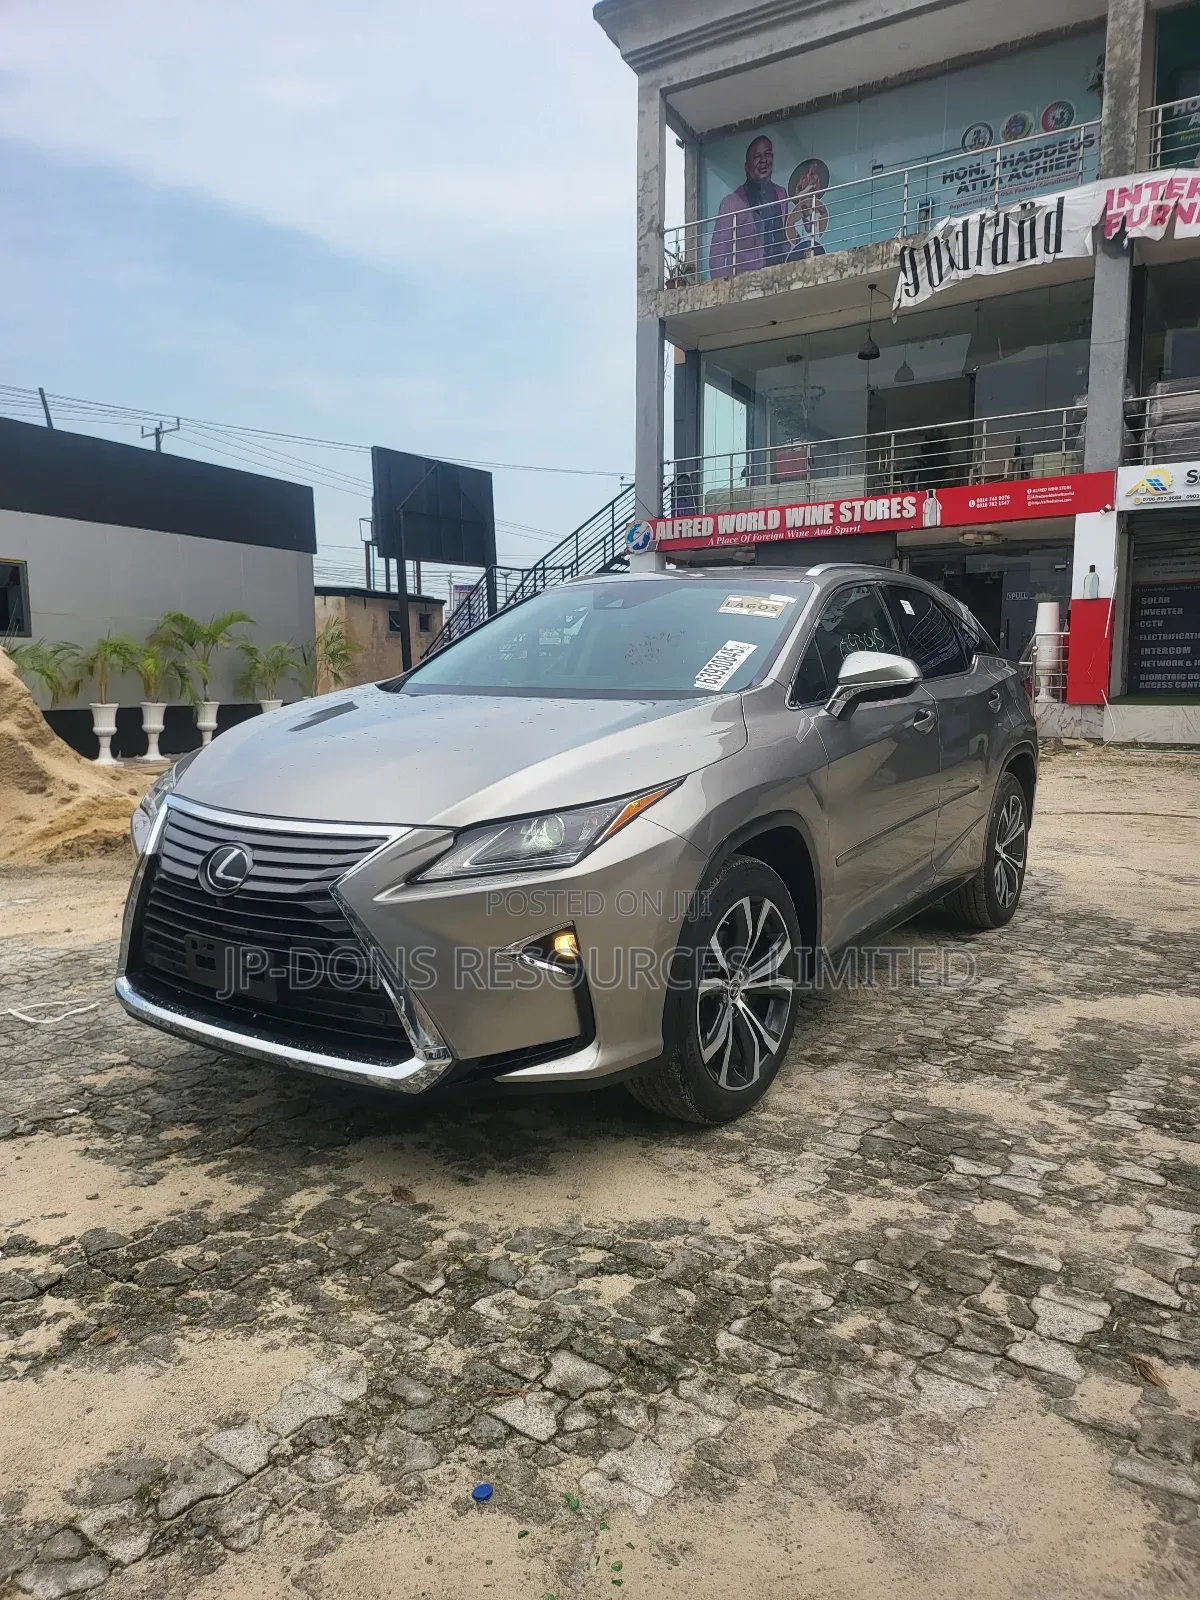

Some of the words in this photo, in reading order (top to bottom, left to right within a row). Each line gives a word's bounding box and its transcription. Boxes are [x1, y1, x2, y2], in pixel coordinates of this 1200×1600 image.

[942, 162, 986, 185] HON.
[956, 170, 1003, 195] ATTA
[1008, 152, 1078, 183] ACHIEF
[1015, 182, 1038, 195] Federal
[656, 516, 714, 541] ALFRED
[718, 509, 780, 535] WORLD
[785, 503, 834, 529] WINE
[839, 496, 917, 523] STORES
[708, 537, 714, 546] A
[717, 536, 739, 545] Place
[741, 534, 751, 544] Of
[752, 530, 784, 543] Foreign
[787, 529, 810, 538] Wine
[814, 526, 832, 536] And
[834, 524, 861, 536] Spirit
[1141, 596, 1171, 605] SOLAR
[726, 601, 779, 612] LAGOS
[1140, 607, 1183, 616] INVERTER
[1140, 619, 1163, 628] CCTV
[1140, 632, 1200, 640] ELECTRIFICATI
[1140, 646, 1191, 655] INTERCOM
[1139, 681, 1173, 689] ACCESS
